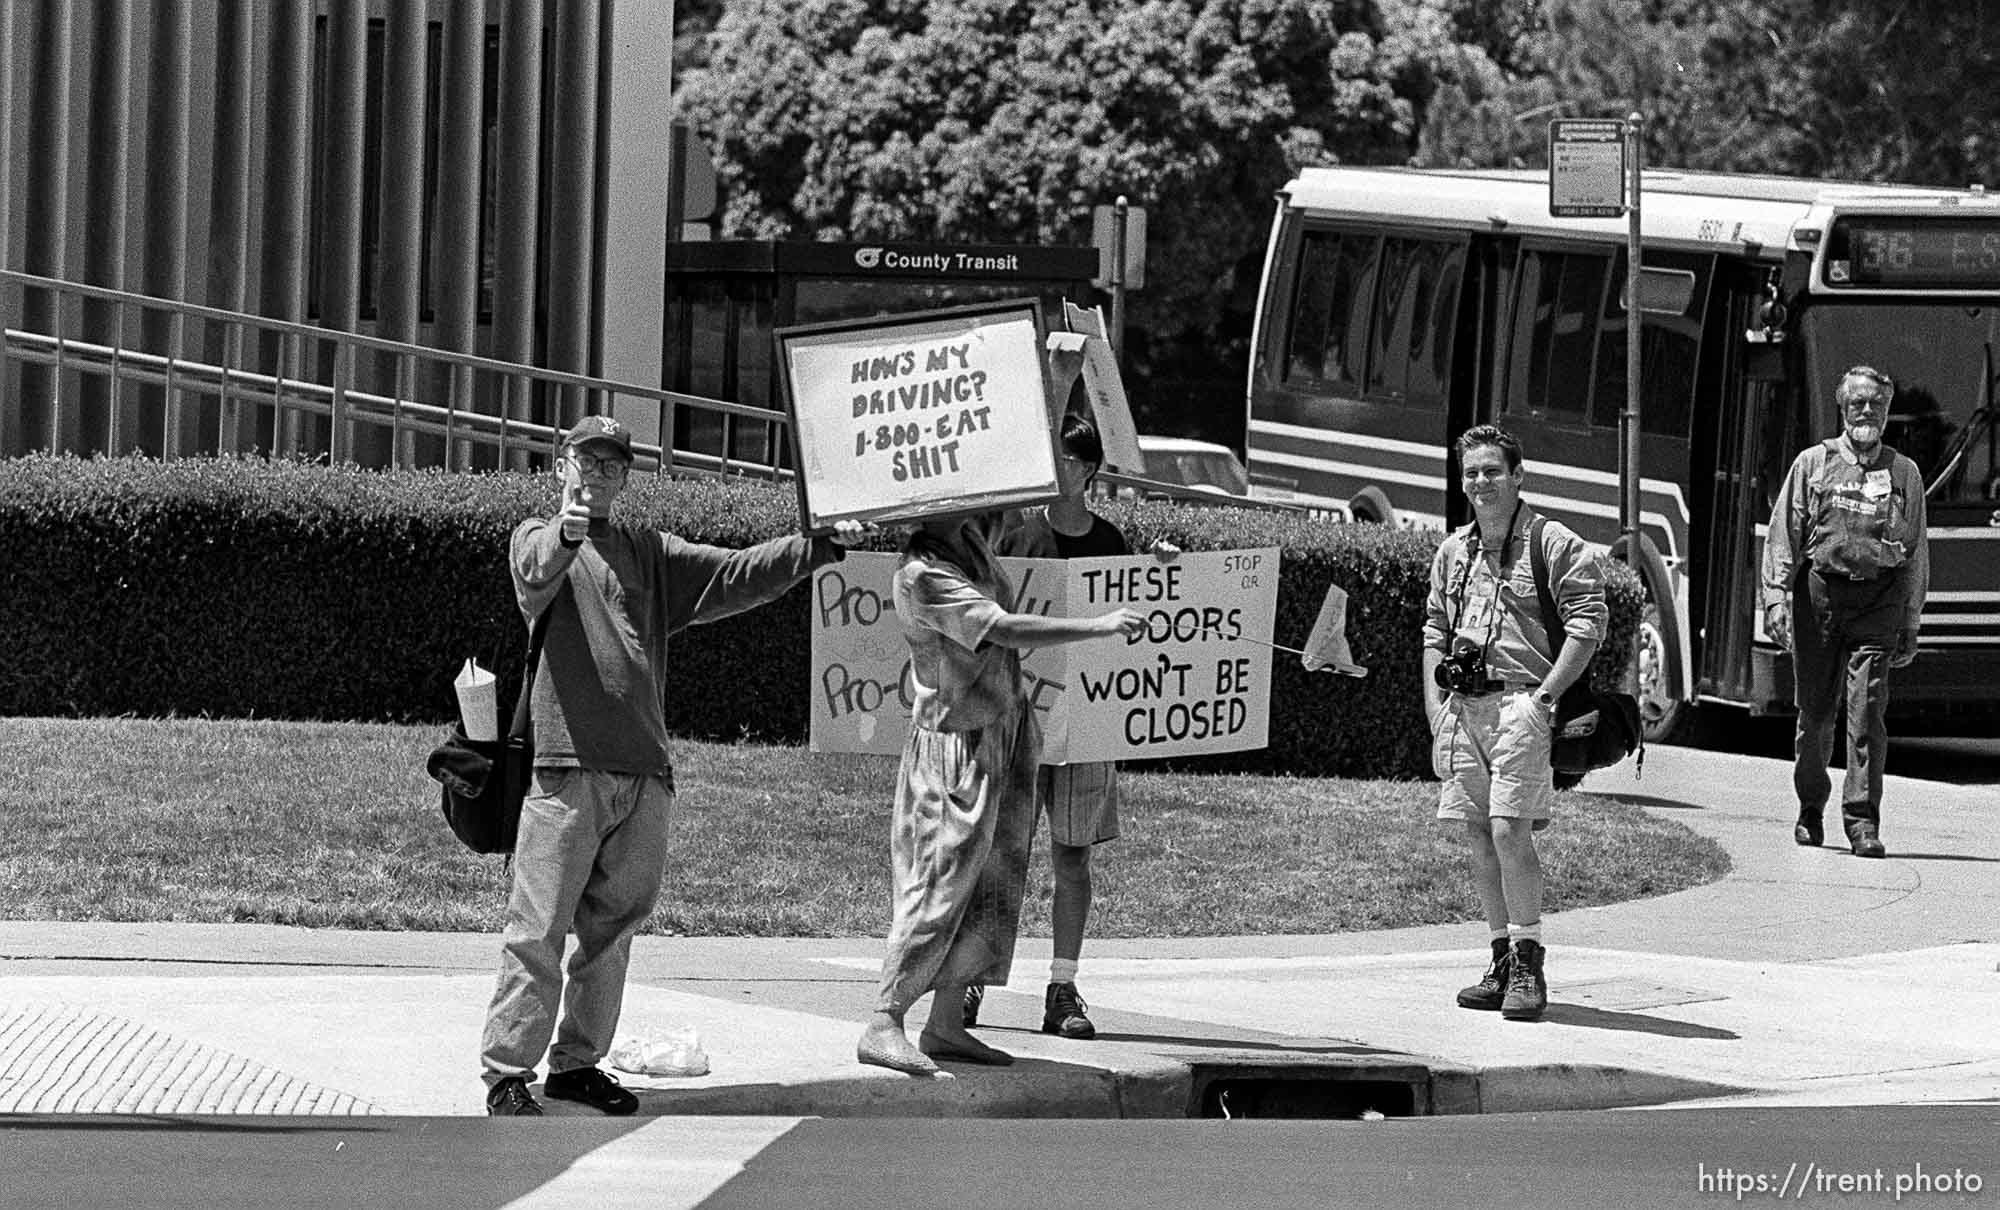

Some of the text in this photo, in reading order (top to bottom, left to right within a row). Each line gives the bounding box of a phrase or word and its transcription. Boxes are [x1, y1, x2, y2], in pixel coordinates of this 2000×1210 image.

[885, 251, 1018, 272] County Transit
[1862, 231, 1914, 268] 36
[926, 343, 969, 373] MY
[852, 370, 987, 419] DRIVING?
[855, 406, 991, 457] 1-800-EAT
[892, 440, 960, 482] SHIT
[1223, 555, 1262, 574] STOP
[1241, 575, 1260, 590] OR
[1081, 565, 1182, 603] THESE
[1080, 653, 1250, 703] WON'T BE
[1125, 697, 1246, 746] CLOSED
